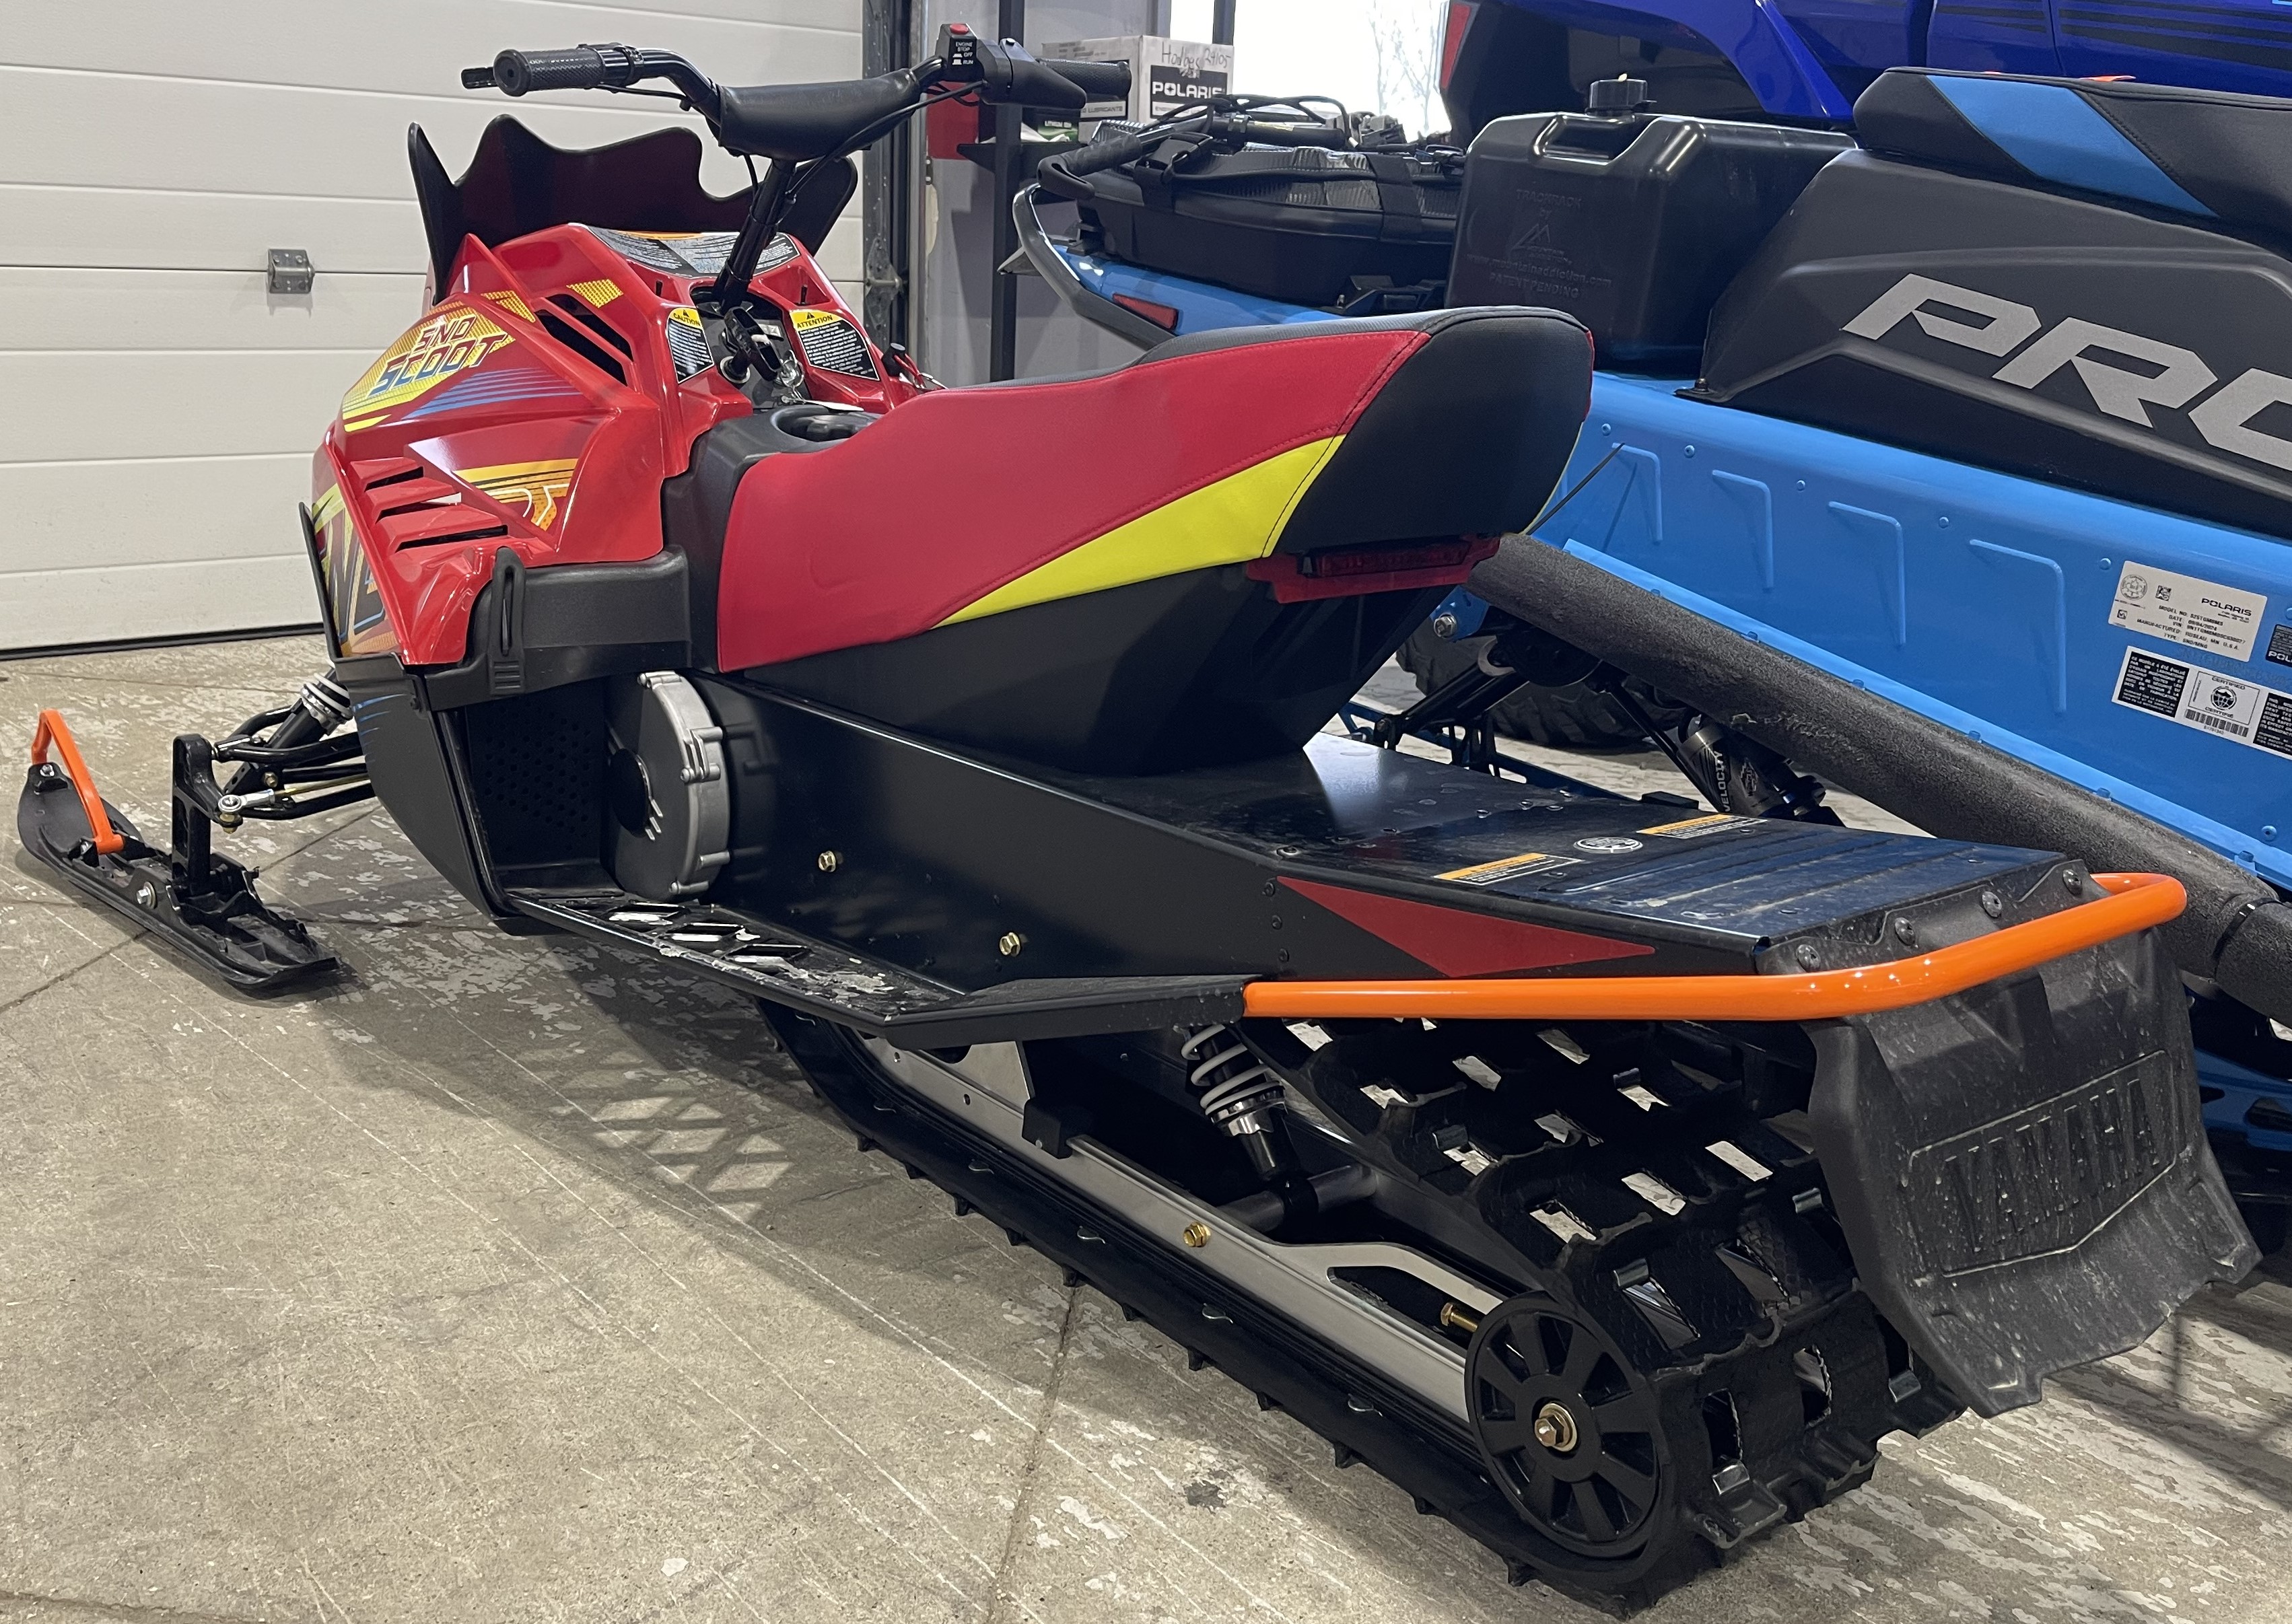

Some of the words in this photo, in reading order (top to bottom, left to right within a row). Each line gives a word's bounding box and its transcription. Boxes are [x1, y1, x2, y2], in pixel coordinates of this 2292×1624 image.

[1490, 273, 1529, 289] PATENT
[1531, 280, 1579, 298] PENDING
[673, 313, 700, 326] CAUTION
[797, 315, 833, 328] ATTENTION
[411, 314, 477, 355] SNO
[366, 330, 508, 398] SCOOT
[2159, 605, 2177, 614] MODEL
[2201, 598, 2252, 616] POLARIS
[2268, 651, 2292, 663] POL
[1714, 750, 1731, 812] VELOCITY
[1944, 1078, 2160, 1253] YAMAHA
